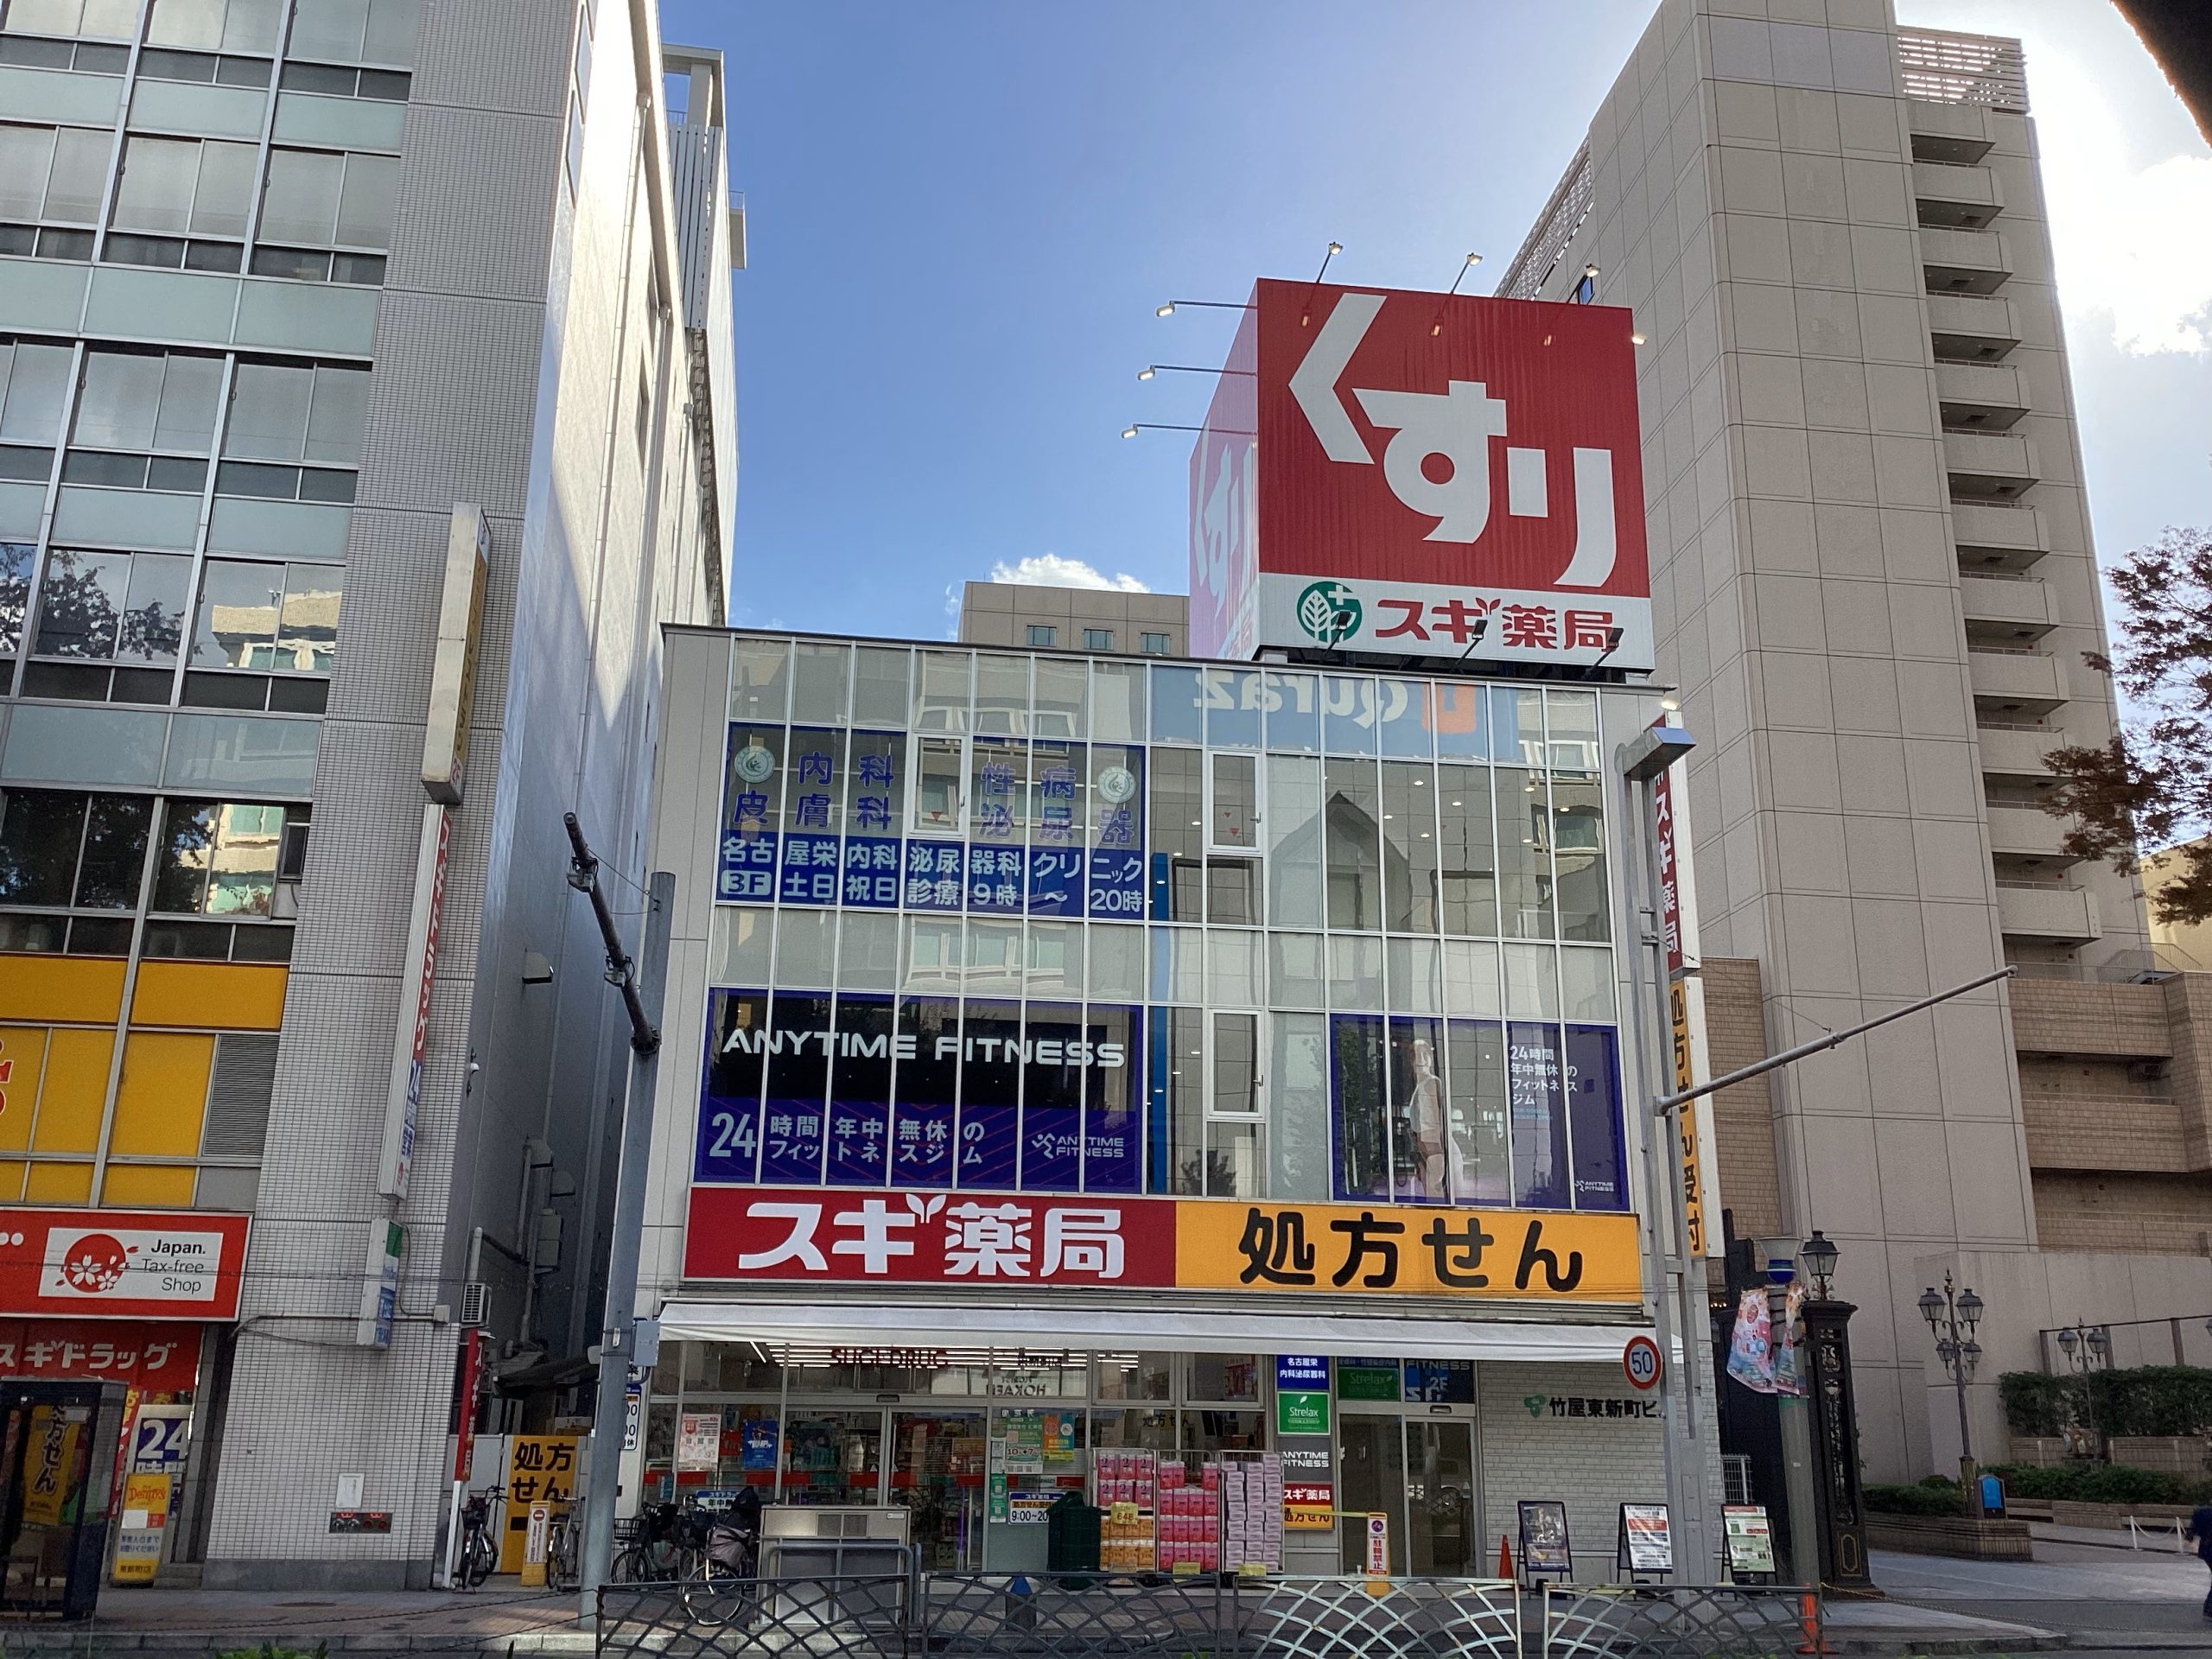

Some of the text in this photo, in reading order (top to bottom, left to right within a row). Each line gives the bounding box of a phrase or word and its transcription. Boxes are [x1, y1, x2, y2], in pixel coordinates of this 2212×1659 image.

[1288, 292, 1618, 587] くすり
[1376, 597, 1615, 652] スギ薬局
[721, 1029, 1124, 1067] ANYTIME FITNESS
[1510, 1046, 1554, 1061] 24時間
[1513, 1093, 1535, 1105] ジム
[1056, 1135, 1124, 1147] ANTIME
[738, 1194, 1124, 1279] スギ薬局
[151, 1239, 207, 1256] Japan.
[1239, 1208, 1583, 1292] 処方せん
[142, 1258, 204, 1274] Tax-free
[162, 1277, 201, 1294] Shop
[1287, 1357, 1318, 1366] 名古屋栄
[1406, 1359, 1470, 1370] FITNESS
[1631, 1351, 1652, 1375] 50
[1289, 1407, 1319, 1417] Strelax
[1549, 1396, 1666, 1418] 竹屋東新町ビ
[138, 1419, 188, 1460] 24
[514, 1441, 575, 1471] 処方
[512, 1476, 569, 1504] せん
[1283, 1488, 1331, 1500] スギ薬局
